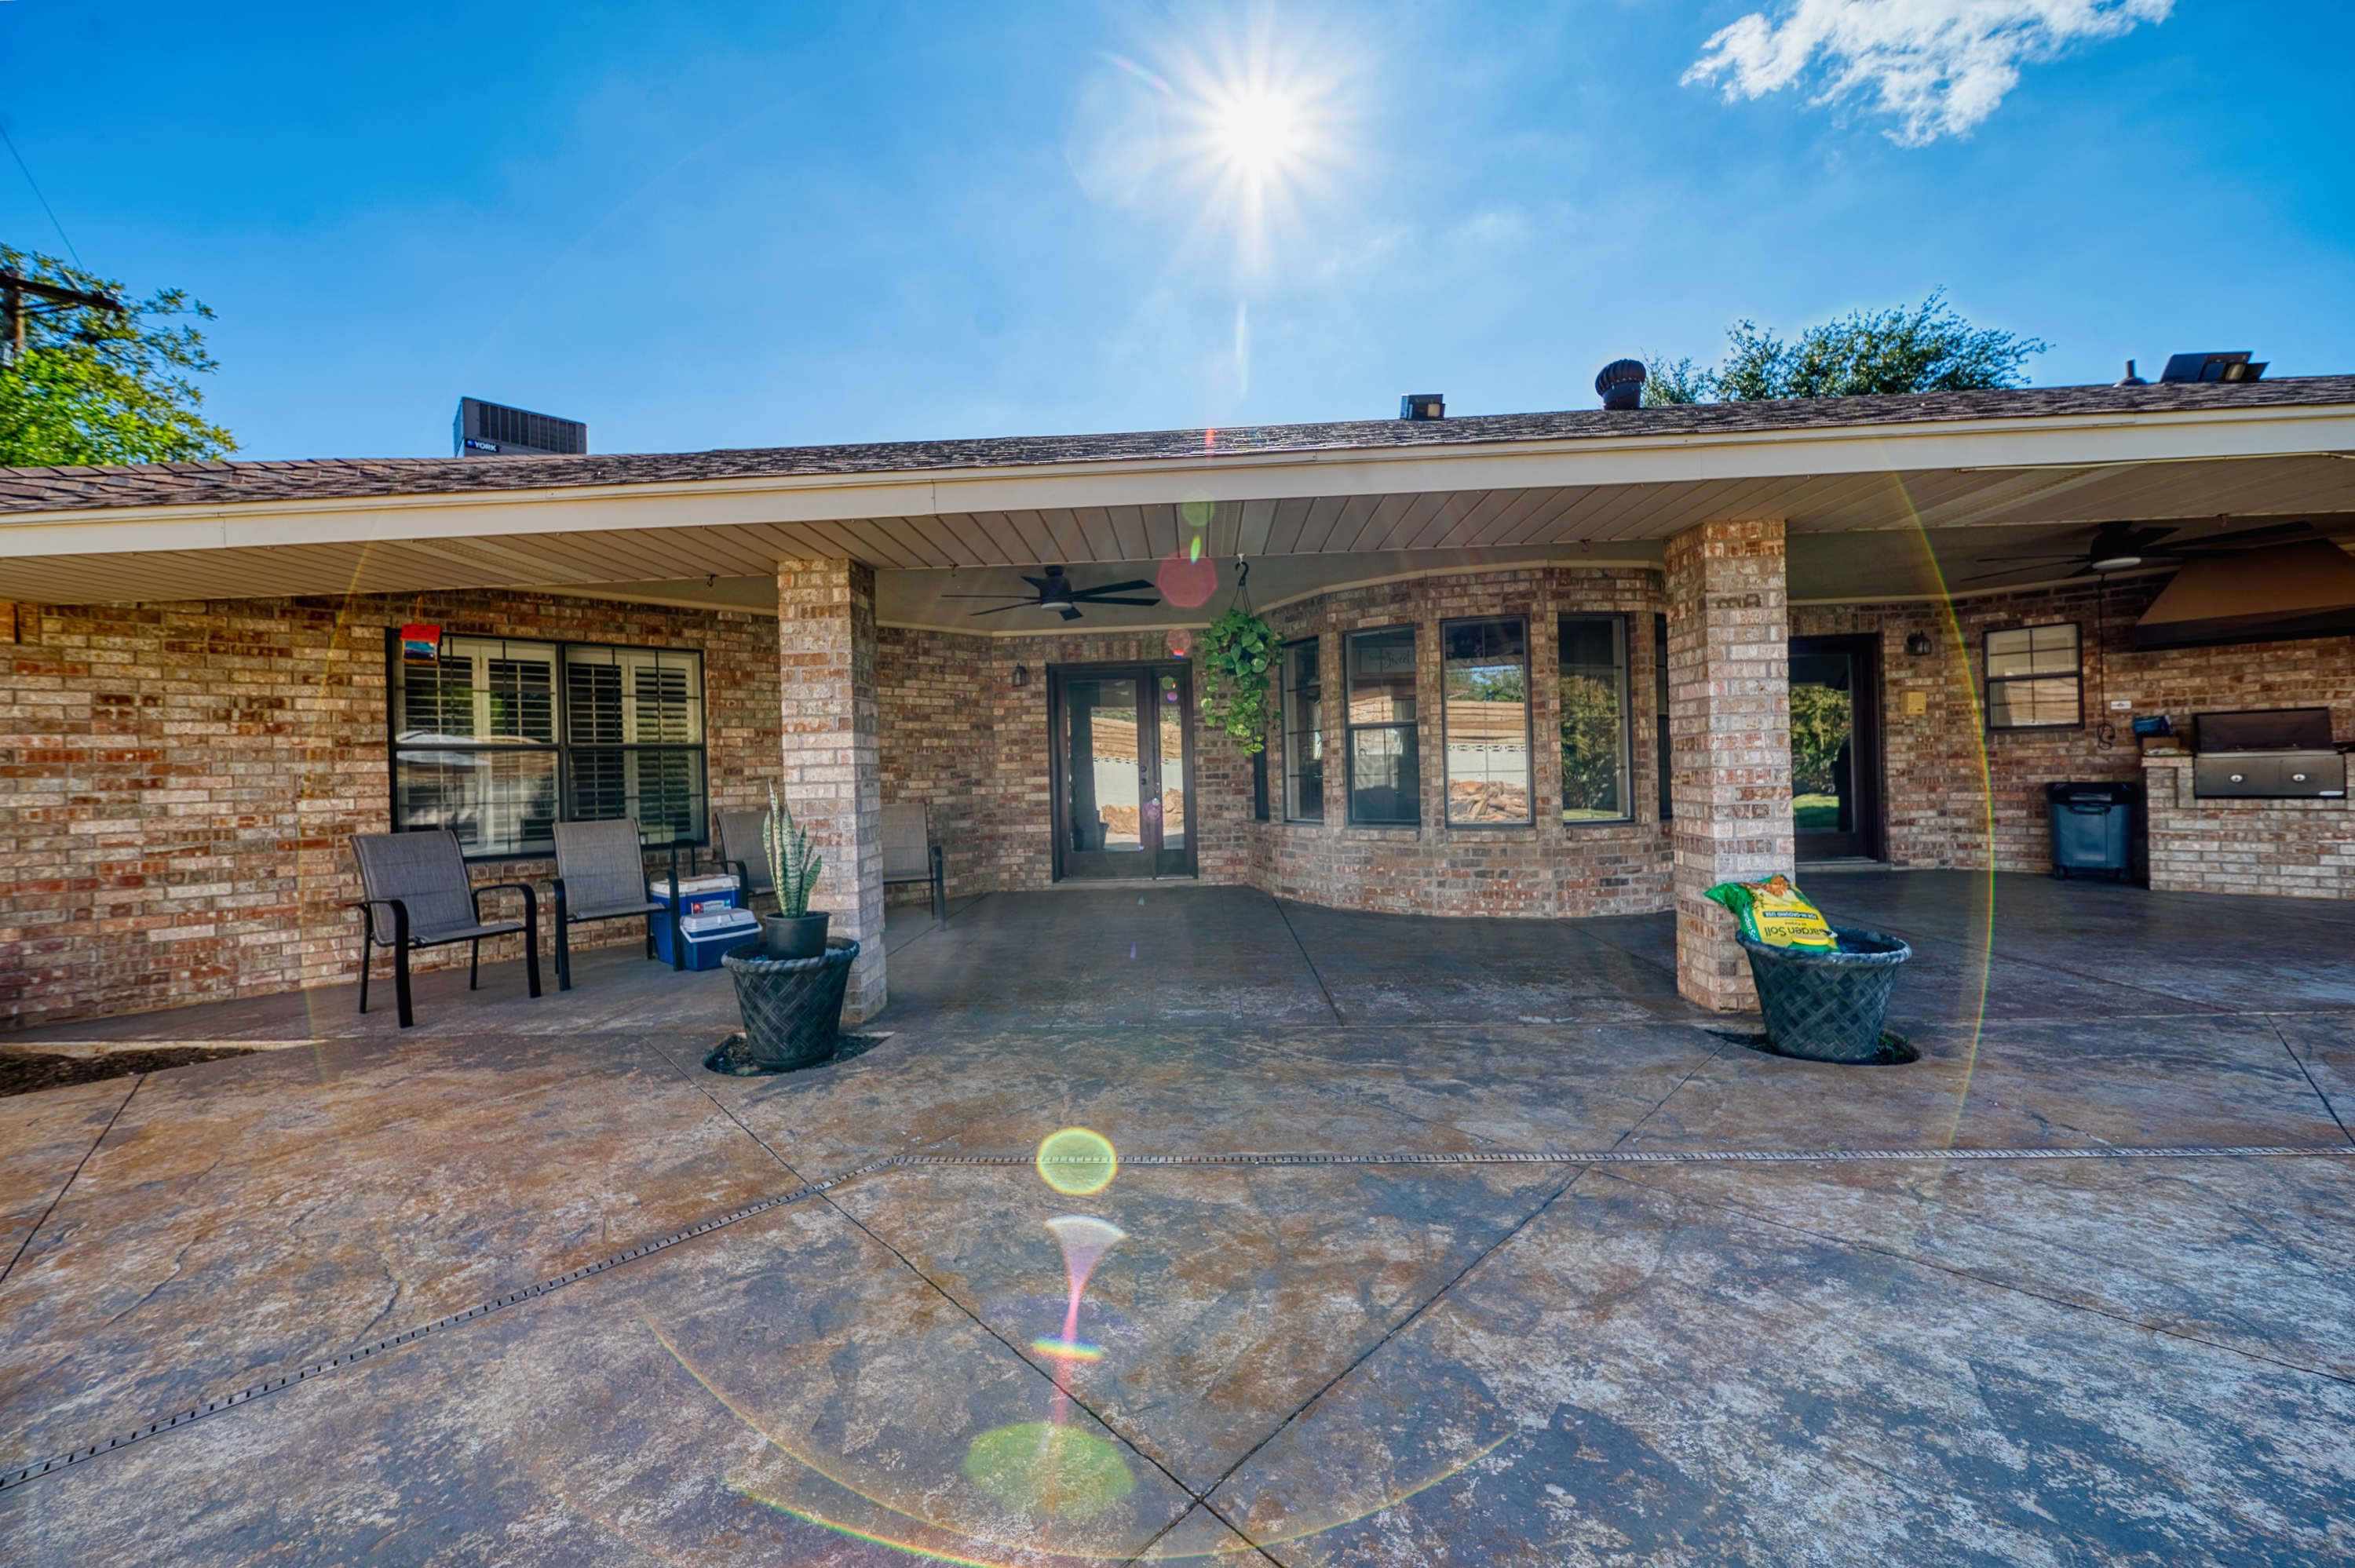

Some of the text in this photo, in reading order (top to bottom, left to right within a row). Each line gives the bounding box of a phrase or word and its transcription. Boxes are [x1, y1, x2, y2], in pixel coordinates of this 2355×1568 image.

[474, 441, 497, 452] YORK
[1383, 649, 1411, 669] Sweet
[1764, 926, 1787, 937] Soil
